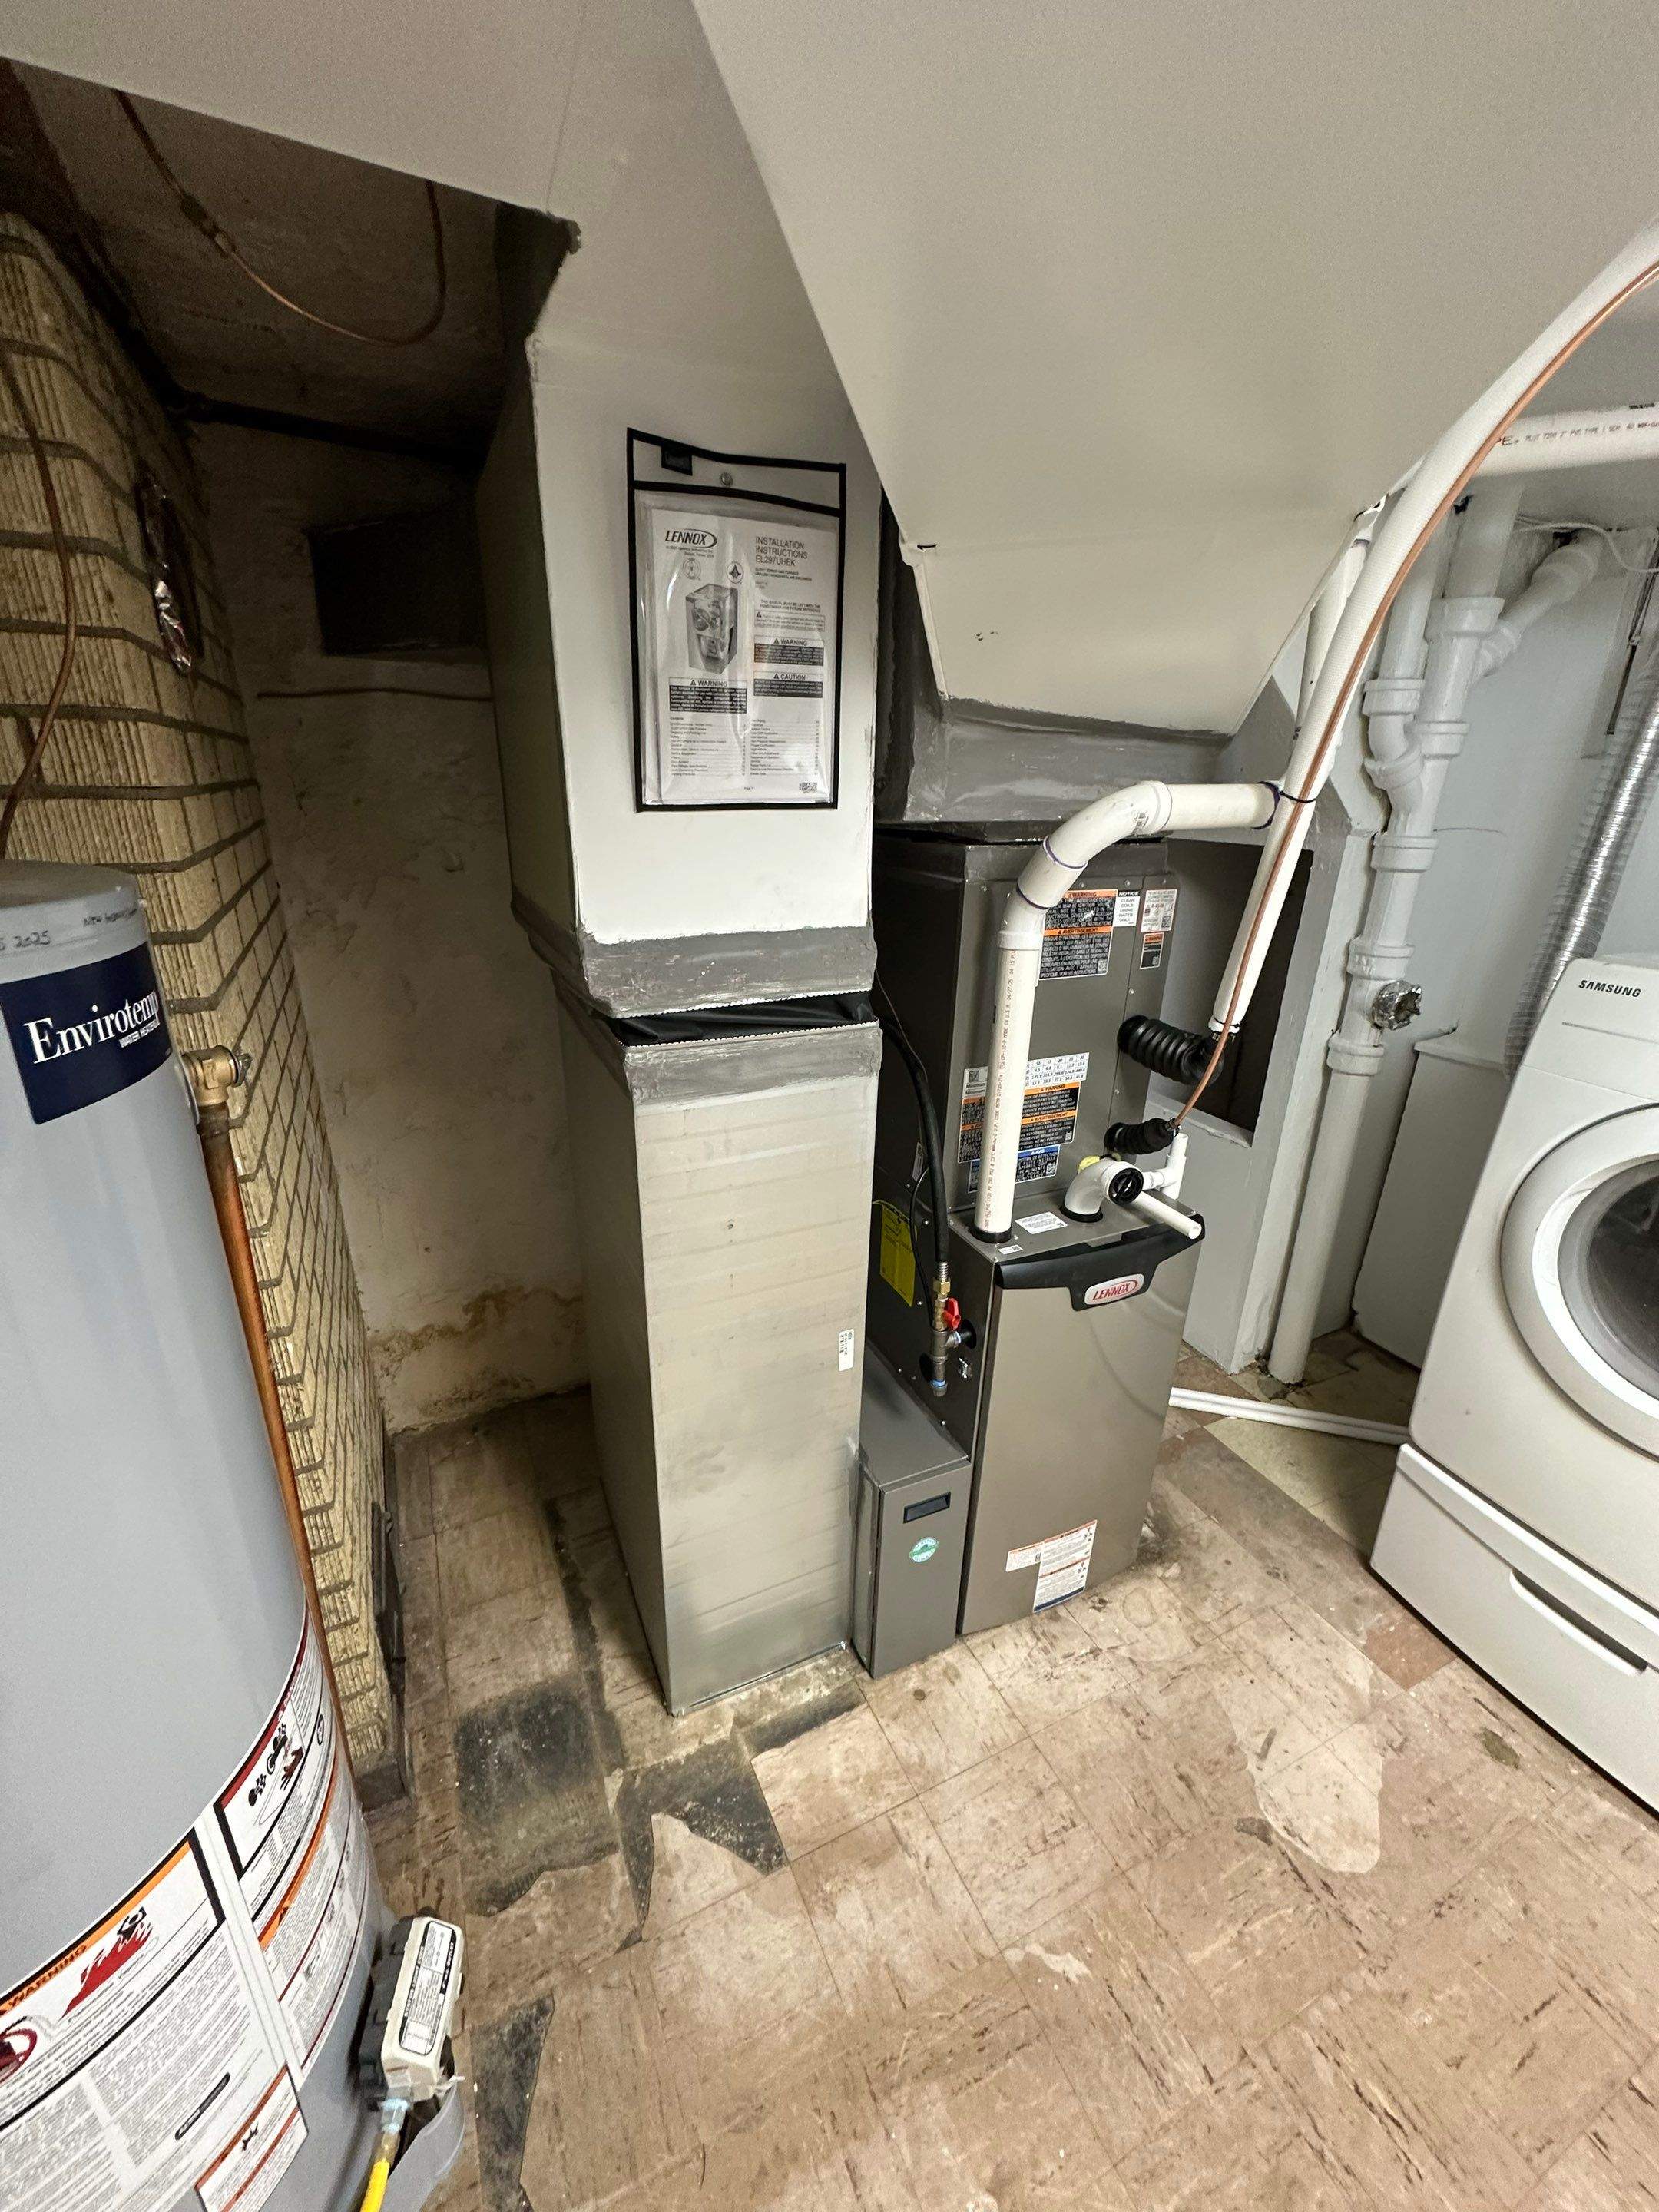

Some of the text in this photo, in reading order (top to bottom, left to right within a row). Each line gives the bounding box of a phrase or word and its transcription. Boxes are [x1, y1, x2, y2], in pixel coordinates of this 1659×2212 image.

[665, 531, 707, 545] LENNOX
[756, 537, 804, 549] INSTALLATION
[756, 546, 807, 559] INSTRUCTIONS
[756, 555, 796, 566] EL297UHEK
[1578, 979, 1642, 998] SAMSUNG
[23, 990, 160, 1064] Envirotemp
[1093, 1283, 1131, 1300] LENNOX
[8, 1944, 87, 2007] WARNING
